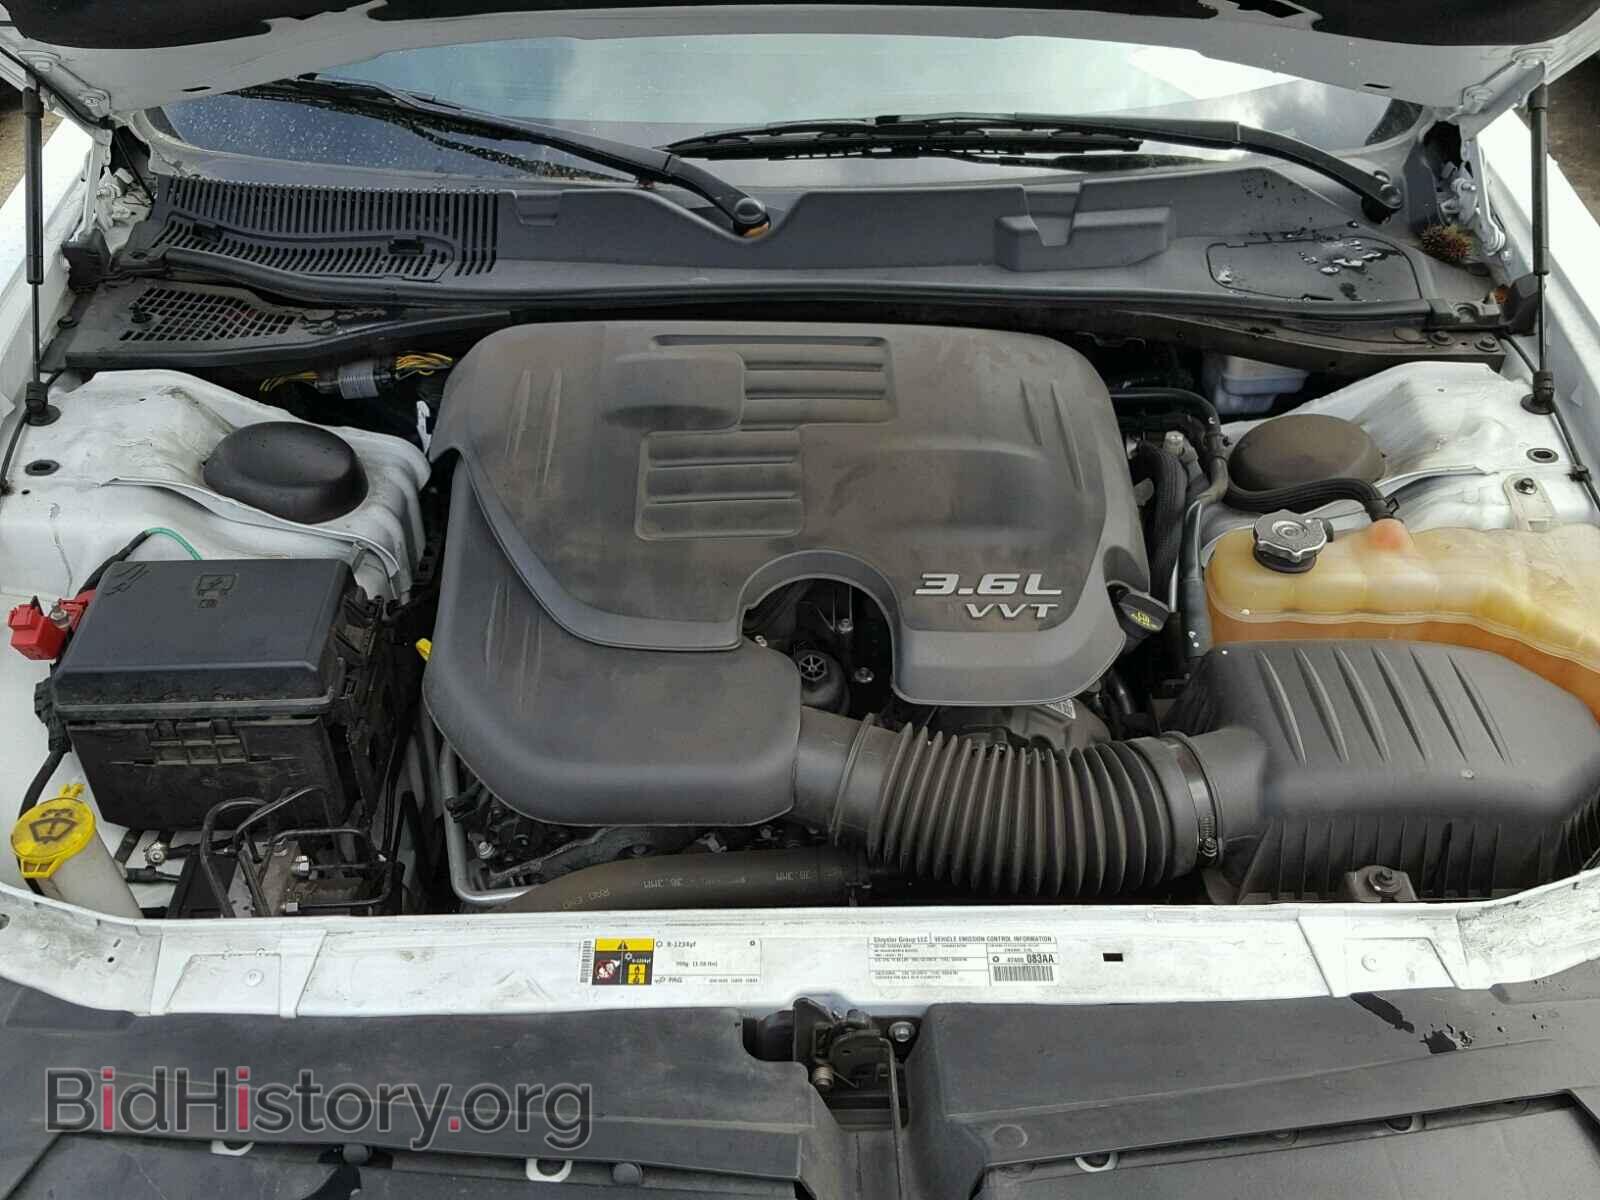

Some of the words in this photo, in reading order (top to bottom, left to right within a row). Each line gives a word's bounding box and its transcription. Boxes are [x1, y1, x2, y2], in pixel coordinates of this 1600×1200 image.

[914, 572, 1063, 596] 3.6L
[965, 602, 1060, 620] VVT
[1026, 953, 1055, 964] 083AA
